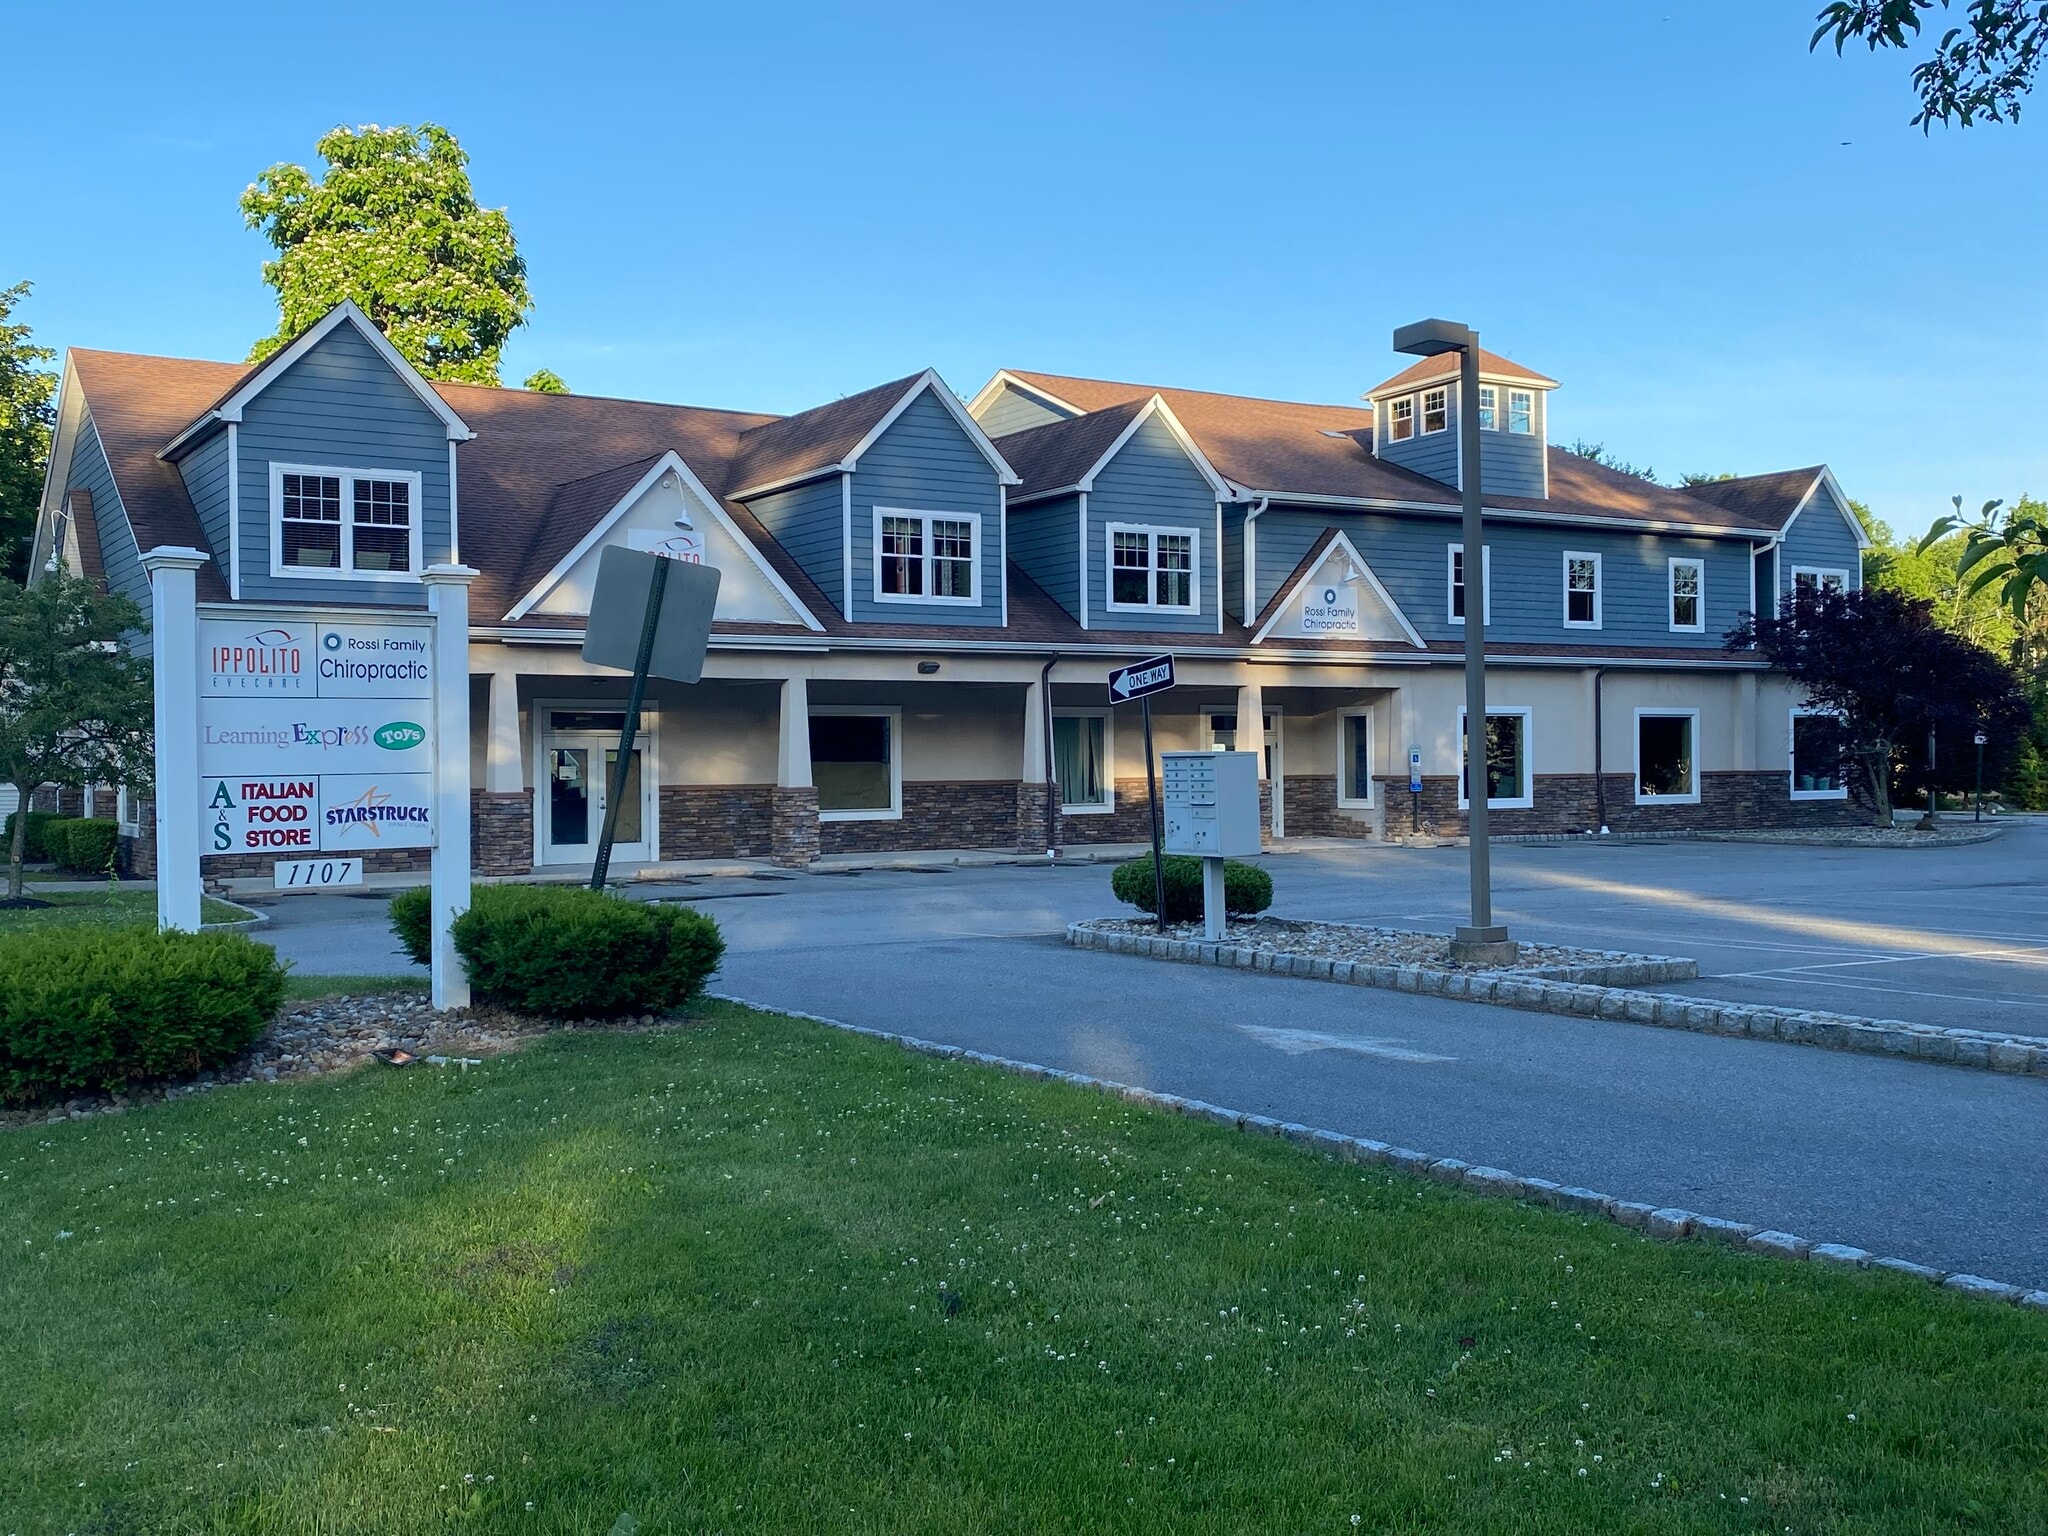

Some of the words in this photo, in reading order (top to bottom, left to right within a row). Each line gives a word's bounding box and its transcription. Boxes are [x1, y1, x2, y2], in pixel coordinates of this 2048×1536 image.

[1304, 606, 1326, 617] Rossi
[1327, 607, 1355, 618] Family
[1303, 619, 1357, 631] Chiropractic
[348, 638, 380, 650] Rossi
[383, 639, 426, 653] Family
[212, 646, 300, 674] IPPOLITO
[319, 658, 428, 682] Chiropractic
[1128, 672, 1149, 688] ONE
[1150, 665, 1167, 682] WAY
[213, 677, 300, 688] EYECARE
[203, 725, 289, 749] Learning
[291, 722, 369, 751] Express
[382, 728, 421, 744] Toys
[208, 780, 237, 809] A
[241, 782, 314, 800] ITALIAN
[218, 809, 227, 821] &
[248, 805, 308, 823] FOOD
[326, 806, 429, 825] STARSTRUCK
[213, 822, 232, 851] S
[245, 828, 311, 848] STORE
[287, 862, 352, 886] 1107
